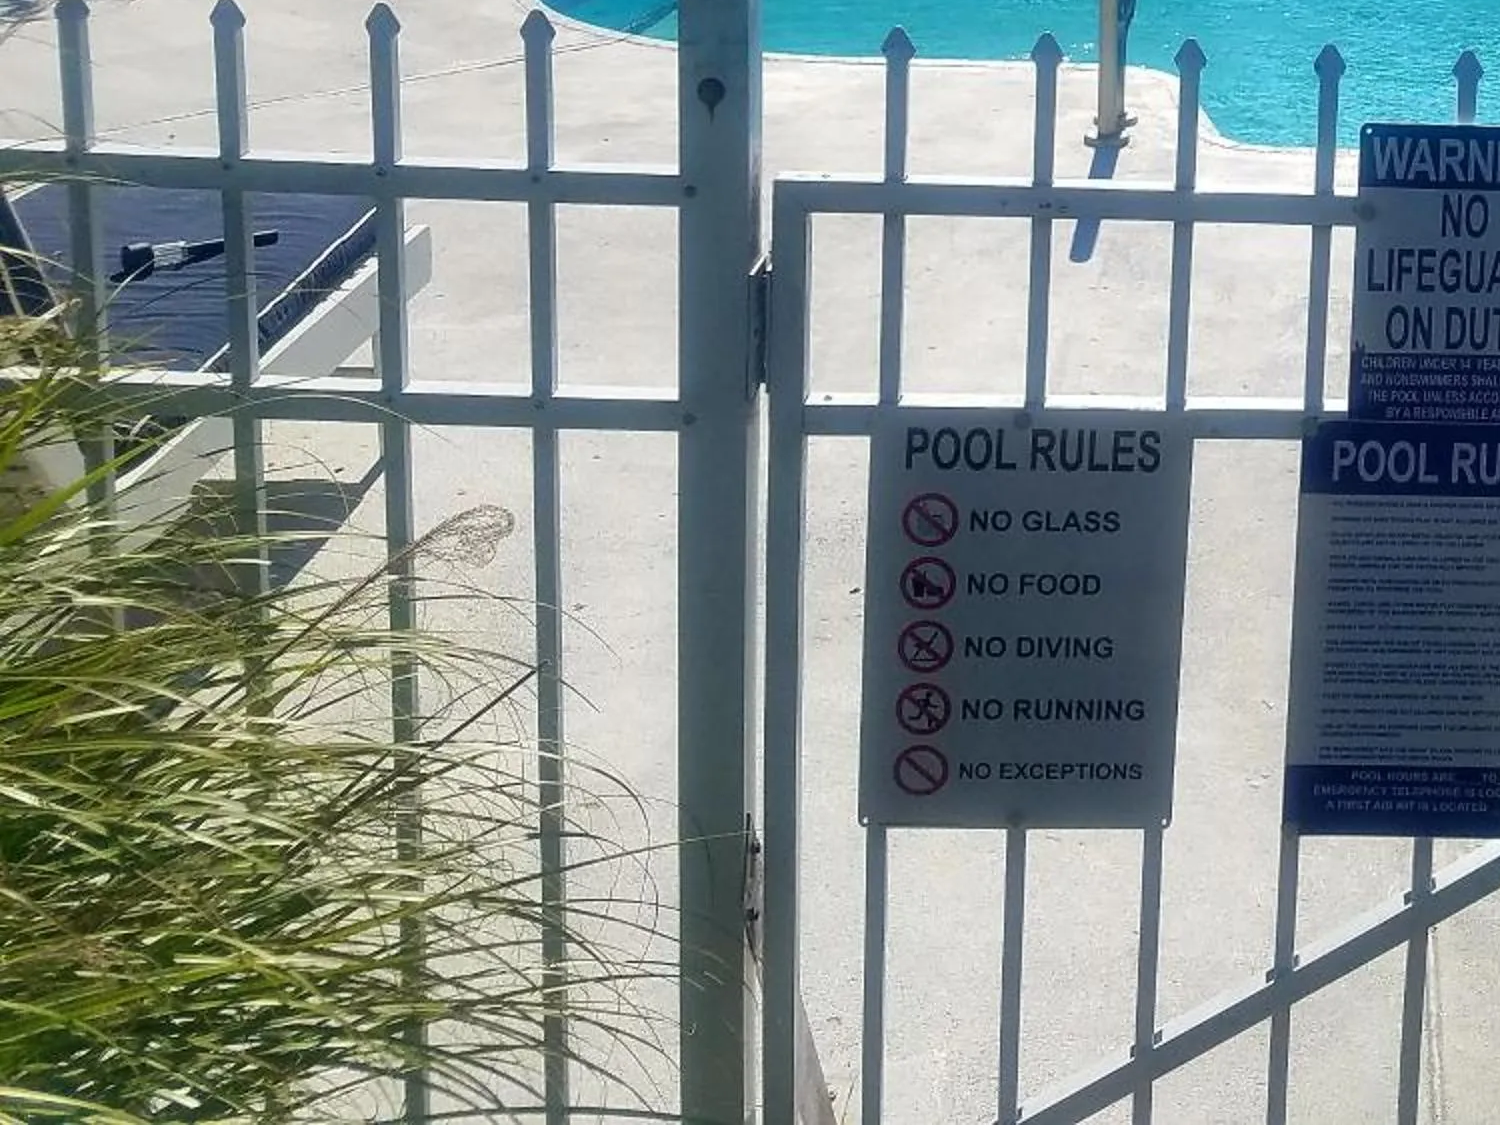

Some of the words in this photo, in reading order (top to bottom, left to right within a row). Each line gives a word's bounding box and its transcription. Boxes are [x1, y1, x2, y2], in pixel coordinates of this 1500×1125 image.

[1441, 193, 1489, 238] NO
[1385, 305, 1433, 350] ON
[905, 427, 1017, 471] POOL
[1030, 429, 1162, 473] RULES
[1332, 440, 1439, 484] POOL
[969, 510, 1012, 532] NO
[1023, 511, 1121, 533] GLASS
[966, 573, 1009, 596] NO
[1019, 574, 1101, 597] FOOD
[964, 637, 1006, 659] NO
[1016, 637, 1114, 659] DIVING
[961, 699, 1003, 721] NO
[1013, 699, 1145, 722] RUNNING
[959, 763, 991, 780] NO
[1000, 762, 1143, 781] EXCEPTIONS
